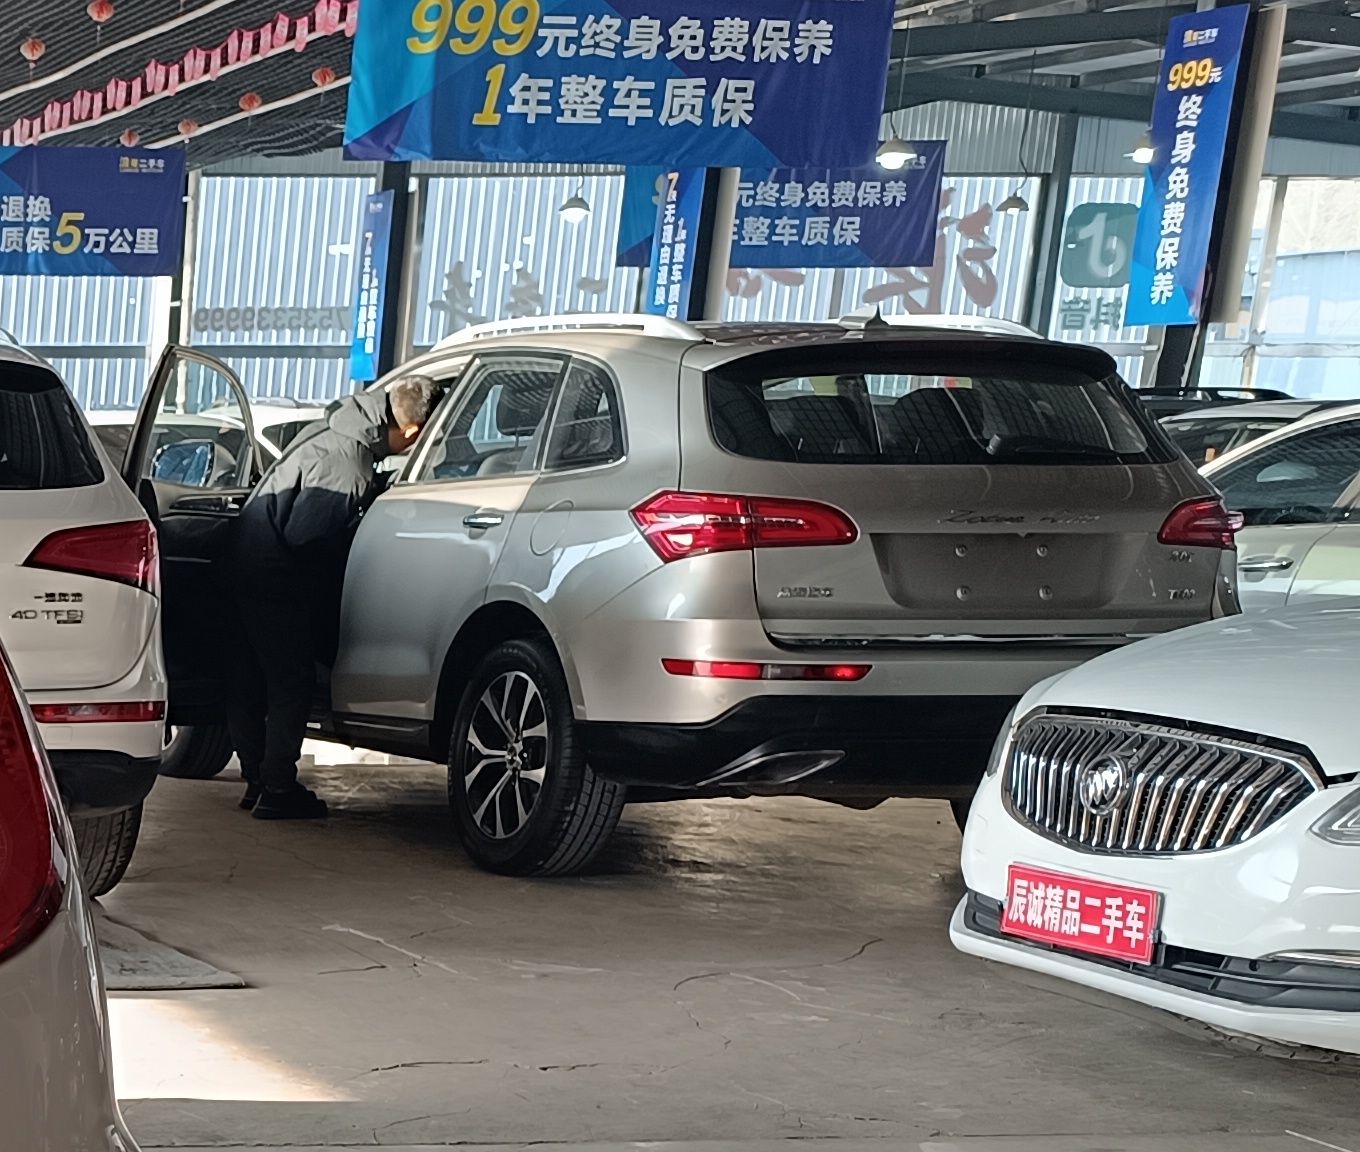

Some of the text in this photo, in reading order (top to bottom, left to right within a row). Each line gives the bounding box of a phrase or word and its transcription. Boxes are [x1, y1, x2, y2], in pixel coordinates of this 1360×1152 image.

[406, 0, 834, 66] 999元终身免费保养
[472, 63, 757, 128] 1年整车质保
[1166, 57, 1223, 92] 999元
[1149, 94, 1204, 306] 终身免费保养
[1008, 878, 1146, 949] 辰诚精品二手车
